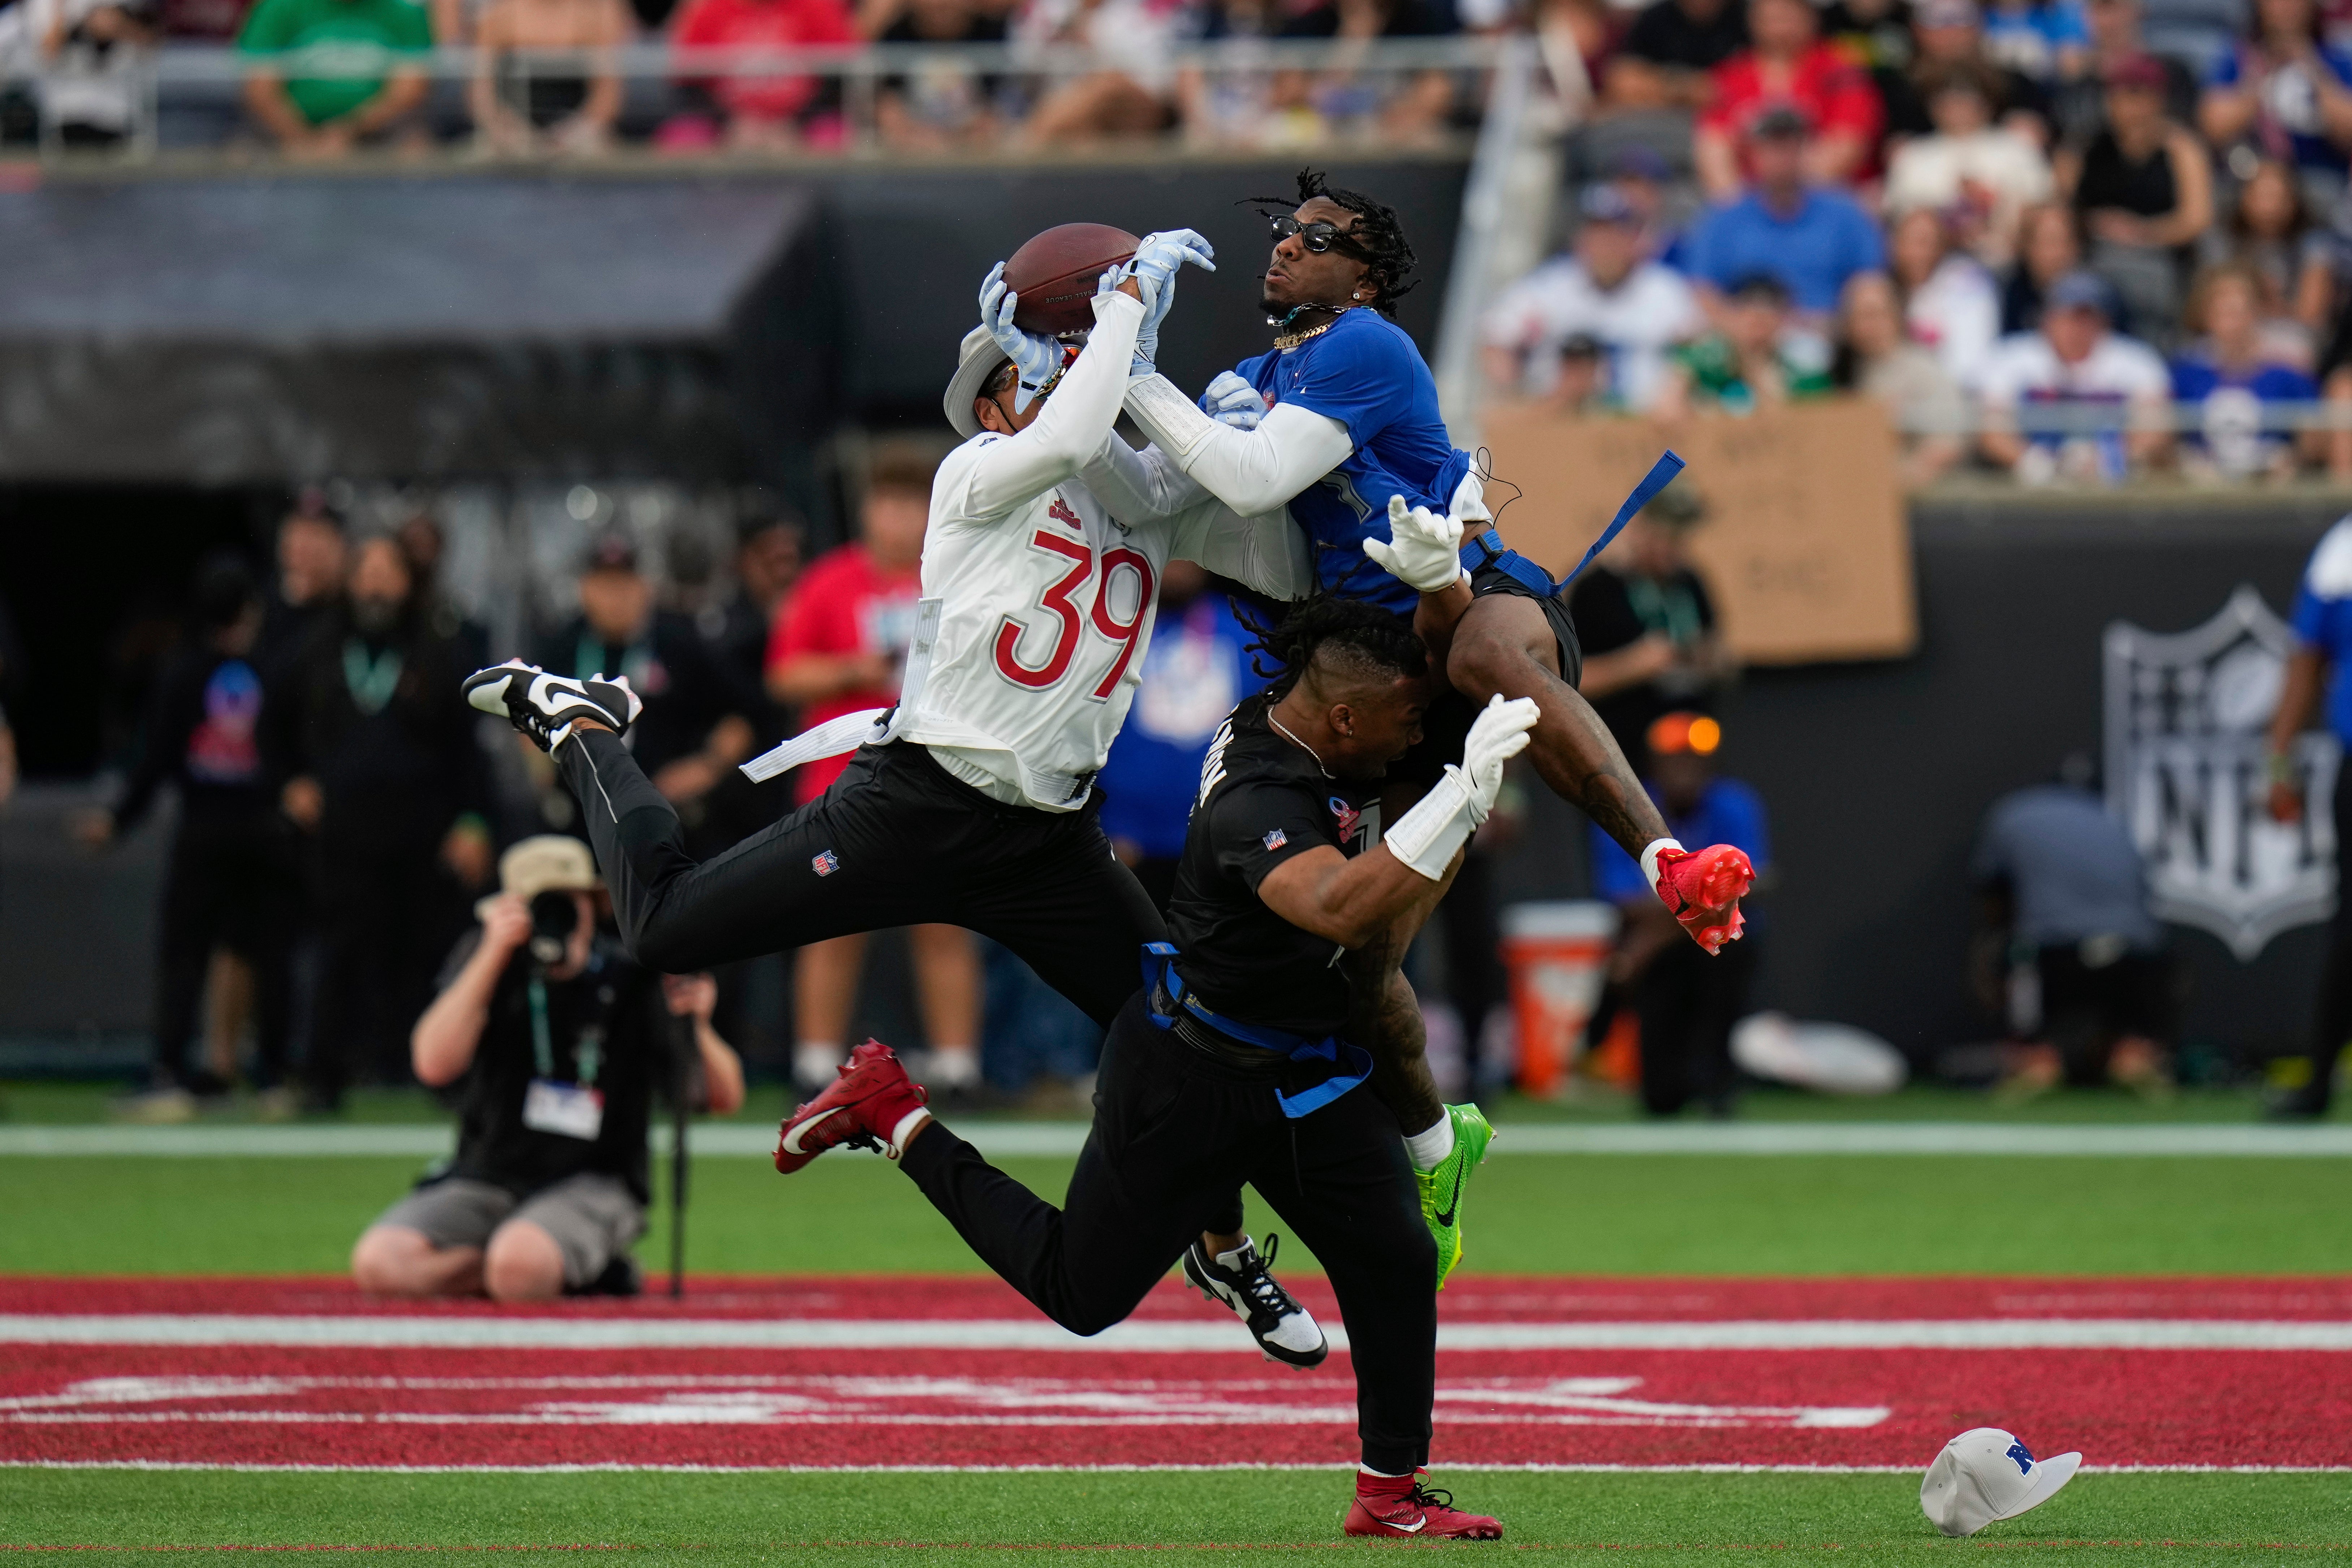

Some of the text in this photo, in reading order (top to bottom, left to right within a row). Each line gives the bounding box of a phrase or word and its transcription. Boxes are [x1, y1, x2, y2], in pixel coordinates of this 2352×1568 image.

[1045, 289, 1097, 303] TBALL LEAGUE
[1049, 505, 1081, 530] GAMES
[990, 523, 1156, 704] 39
[815, 856, 829, 874] NFL
